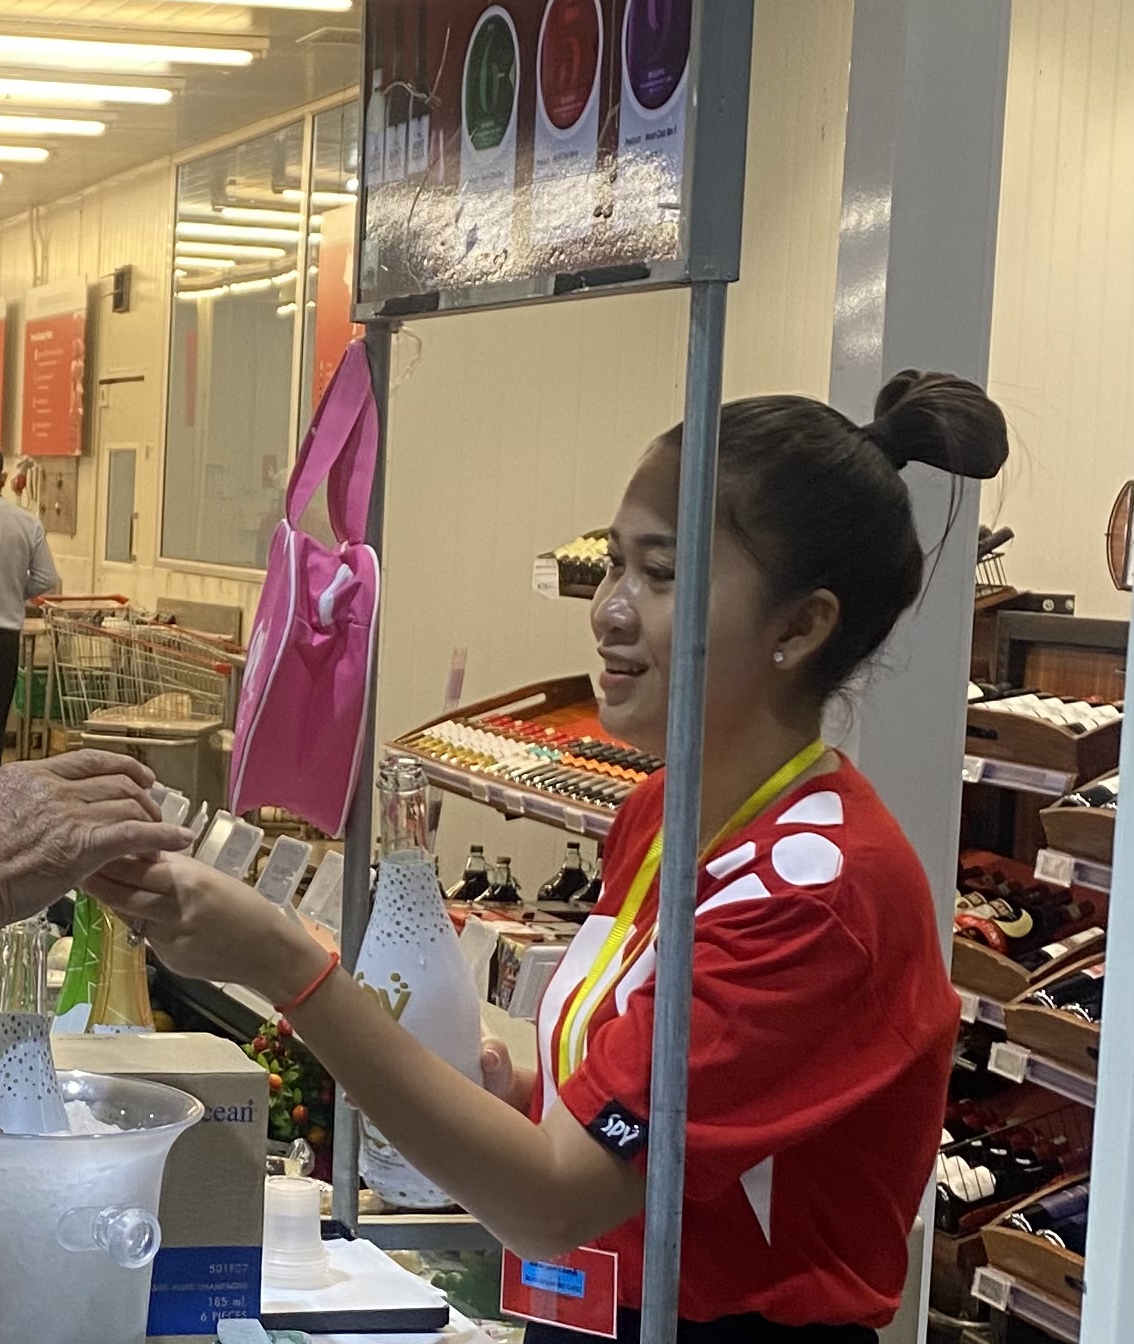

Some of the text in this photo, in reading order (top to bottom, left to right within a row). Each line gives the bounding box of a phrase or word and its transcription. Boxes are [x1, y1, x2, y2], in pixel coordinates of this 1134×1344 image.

[202, 1100, 253, 1123] cean
[601, 1114, 640, 1147] SPY
[232, 1295, 245, 1307] ml
